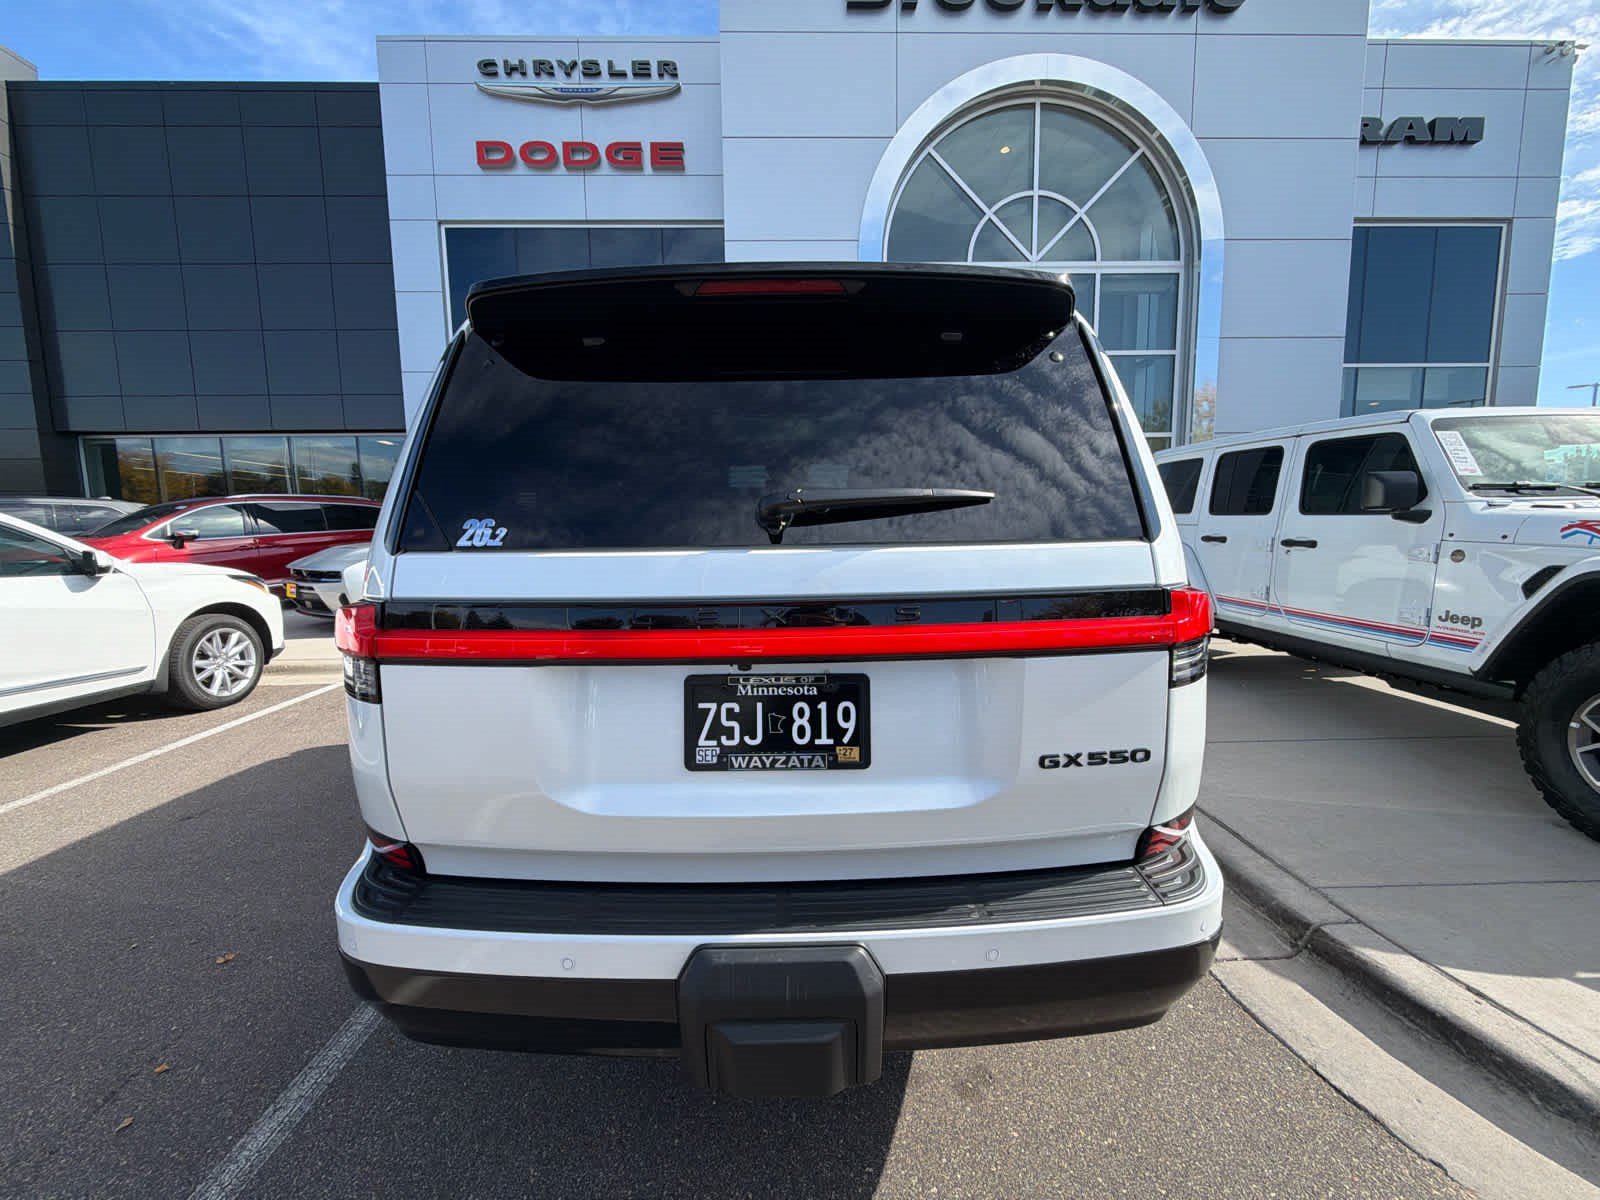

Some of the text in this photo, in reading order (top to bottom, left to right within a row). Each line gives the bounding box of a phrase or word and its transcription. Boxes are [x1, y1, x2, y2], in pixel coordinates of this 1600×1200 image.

[477, 58, 680, 78] CHRYSLER
[1360, 116, 1485, 144] RAM
[475, 140, 685, 173] DODGE
[456, 518, 508, 547] 26.2
[1437, 609, 1483, 630] Jeep
[737, 684, 818, 696] Minnesota
[740, 676, 796, 684] LEXUS
[697, 700, 857, 747] ZSJ 819
[697, 748, 717, 763] SEP
[731, 755, 825, 769] WAYZATA
[1038, 747, 1152, 770] GX550
